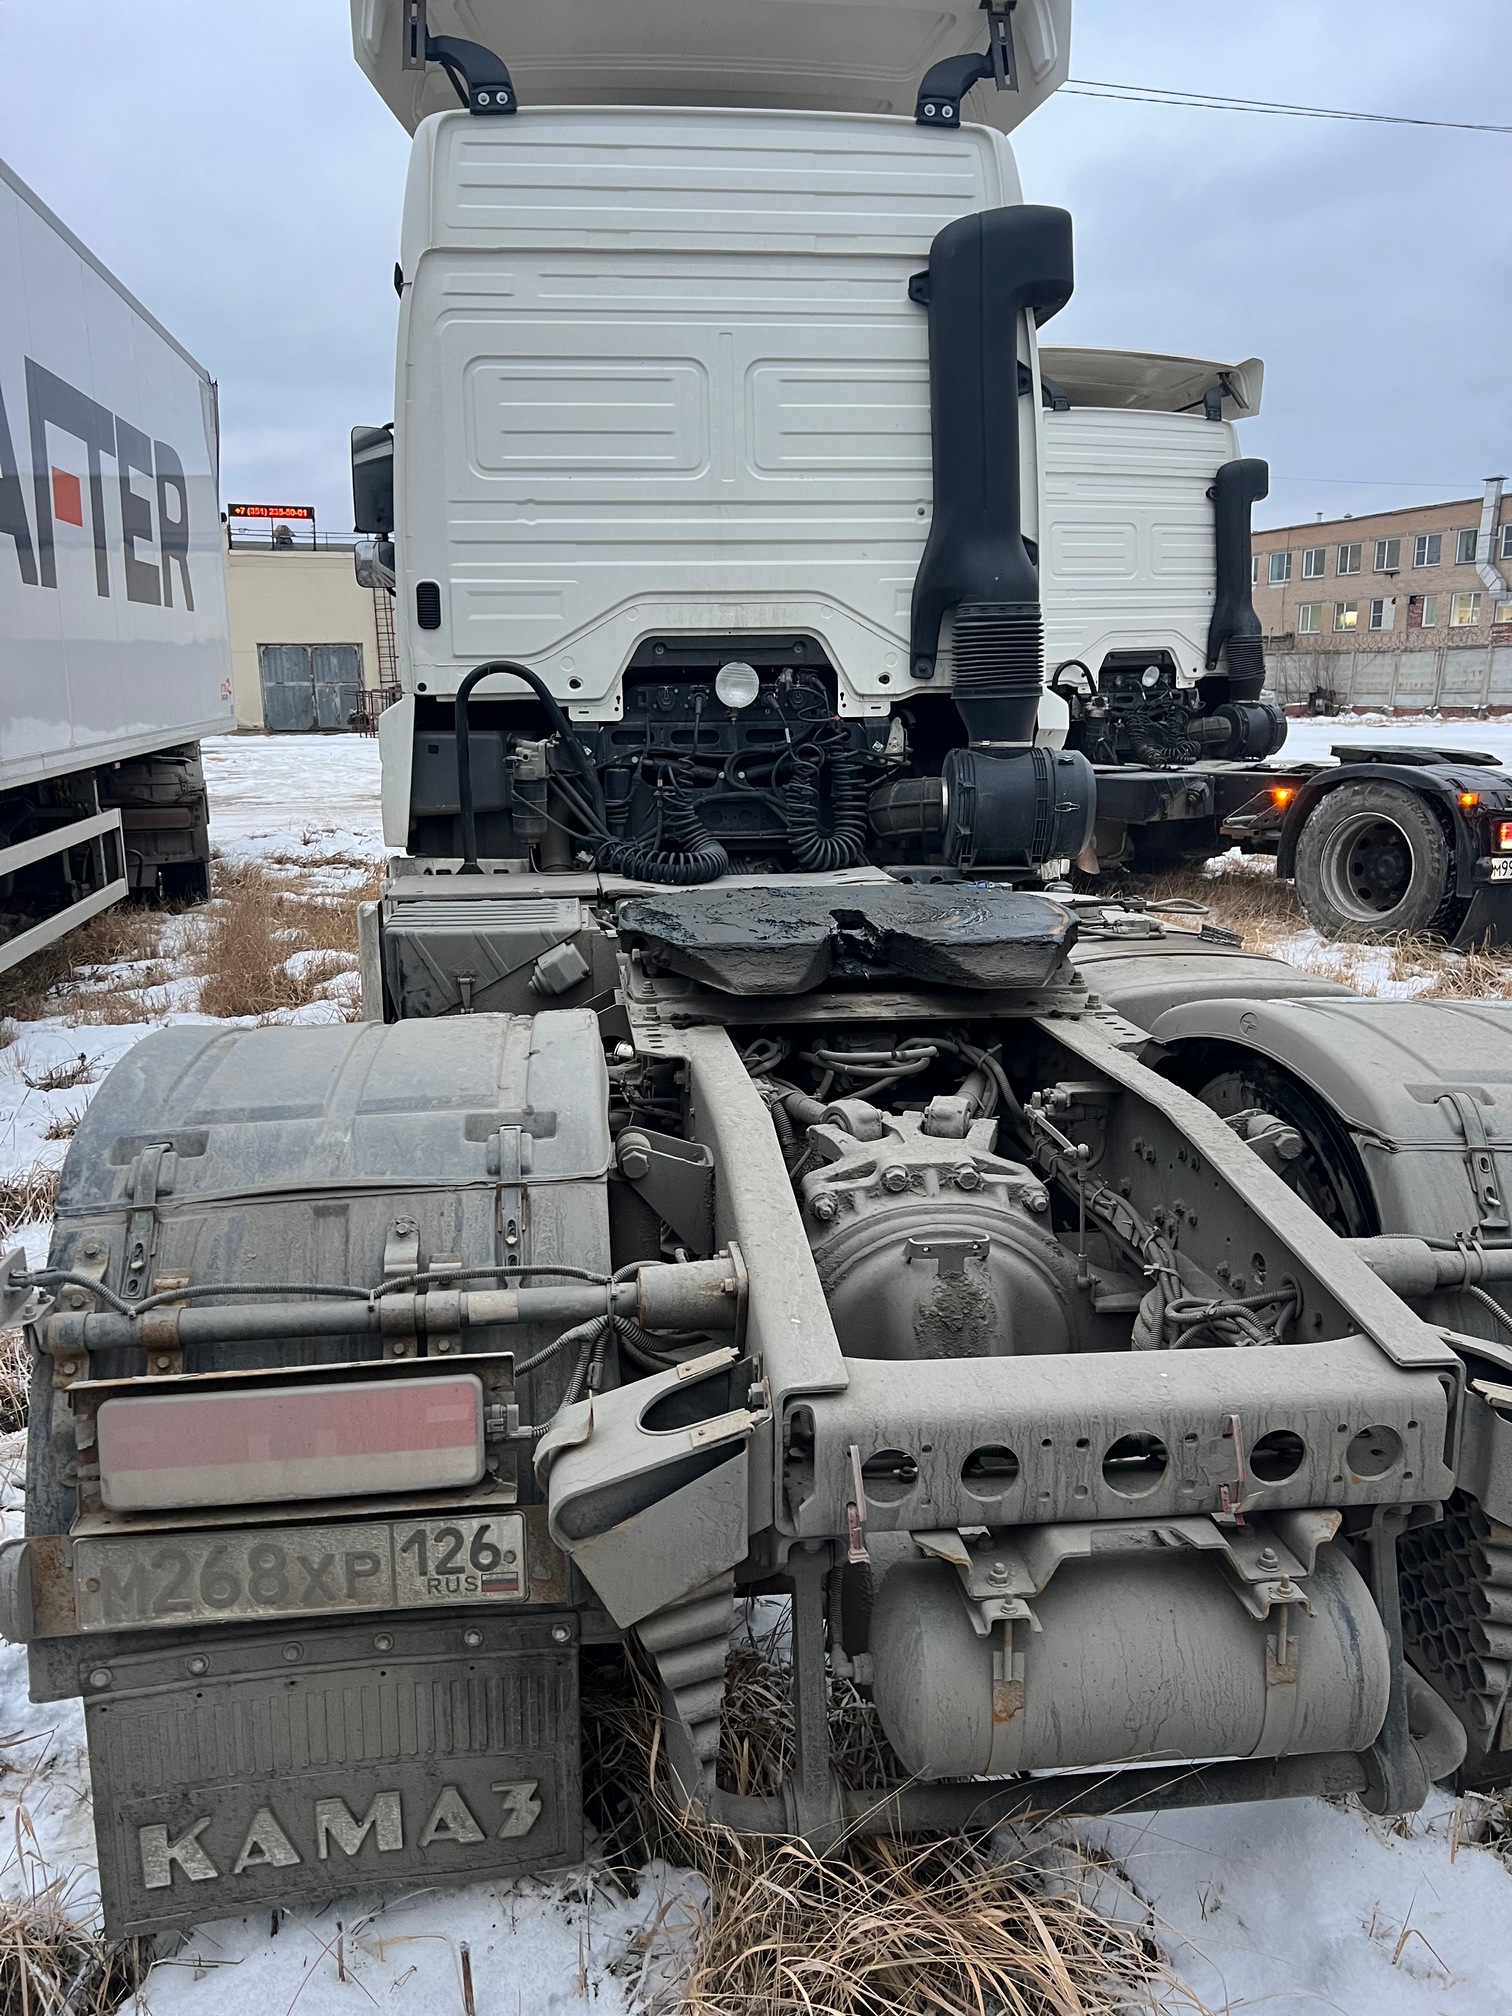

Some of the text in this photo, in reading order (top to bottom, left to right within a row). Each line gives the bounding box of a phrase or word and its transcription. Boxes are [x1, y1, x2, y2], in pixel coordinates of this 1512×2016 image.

[235, 506, 246, 515] +7
[247, 507, 268, 517] (351)
[401, 1524, 501, 1577] 126
[427, 1575, 480, 1595] RUS
[138, 1779, 543, 1889] КАМАЗ
